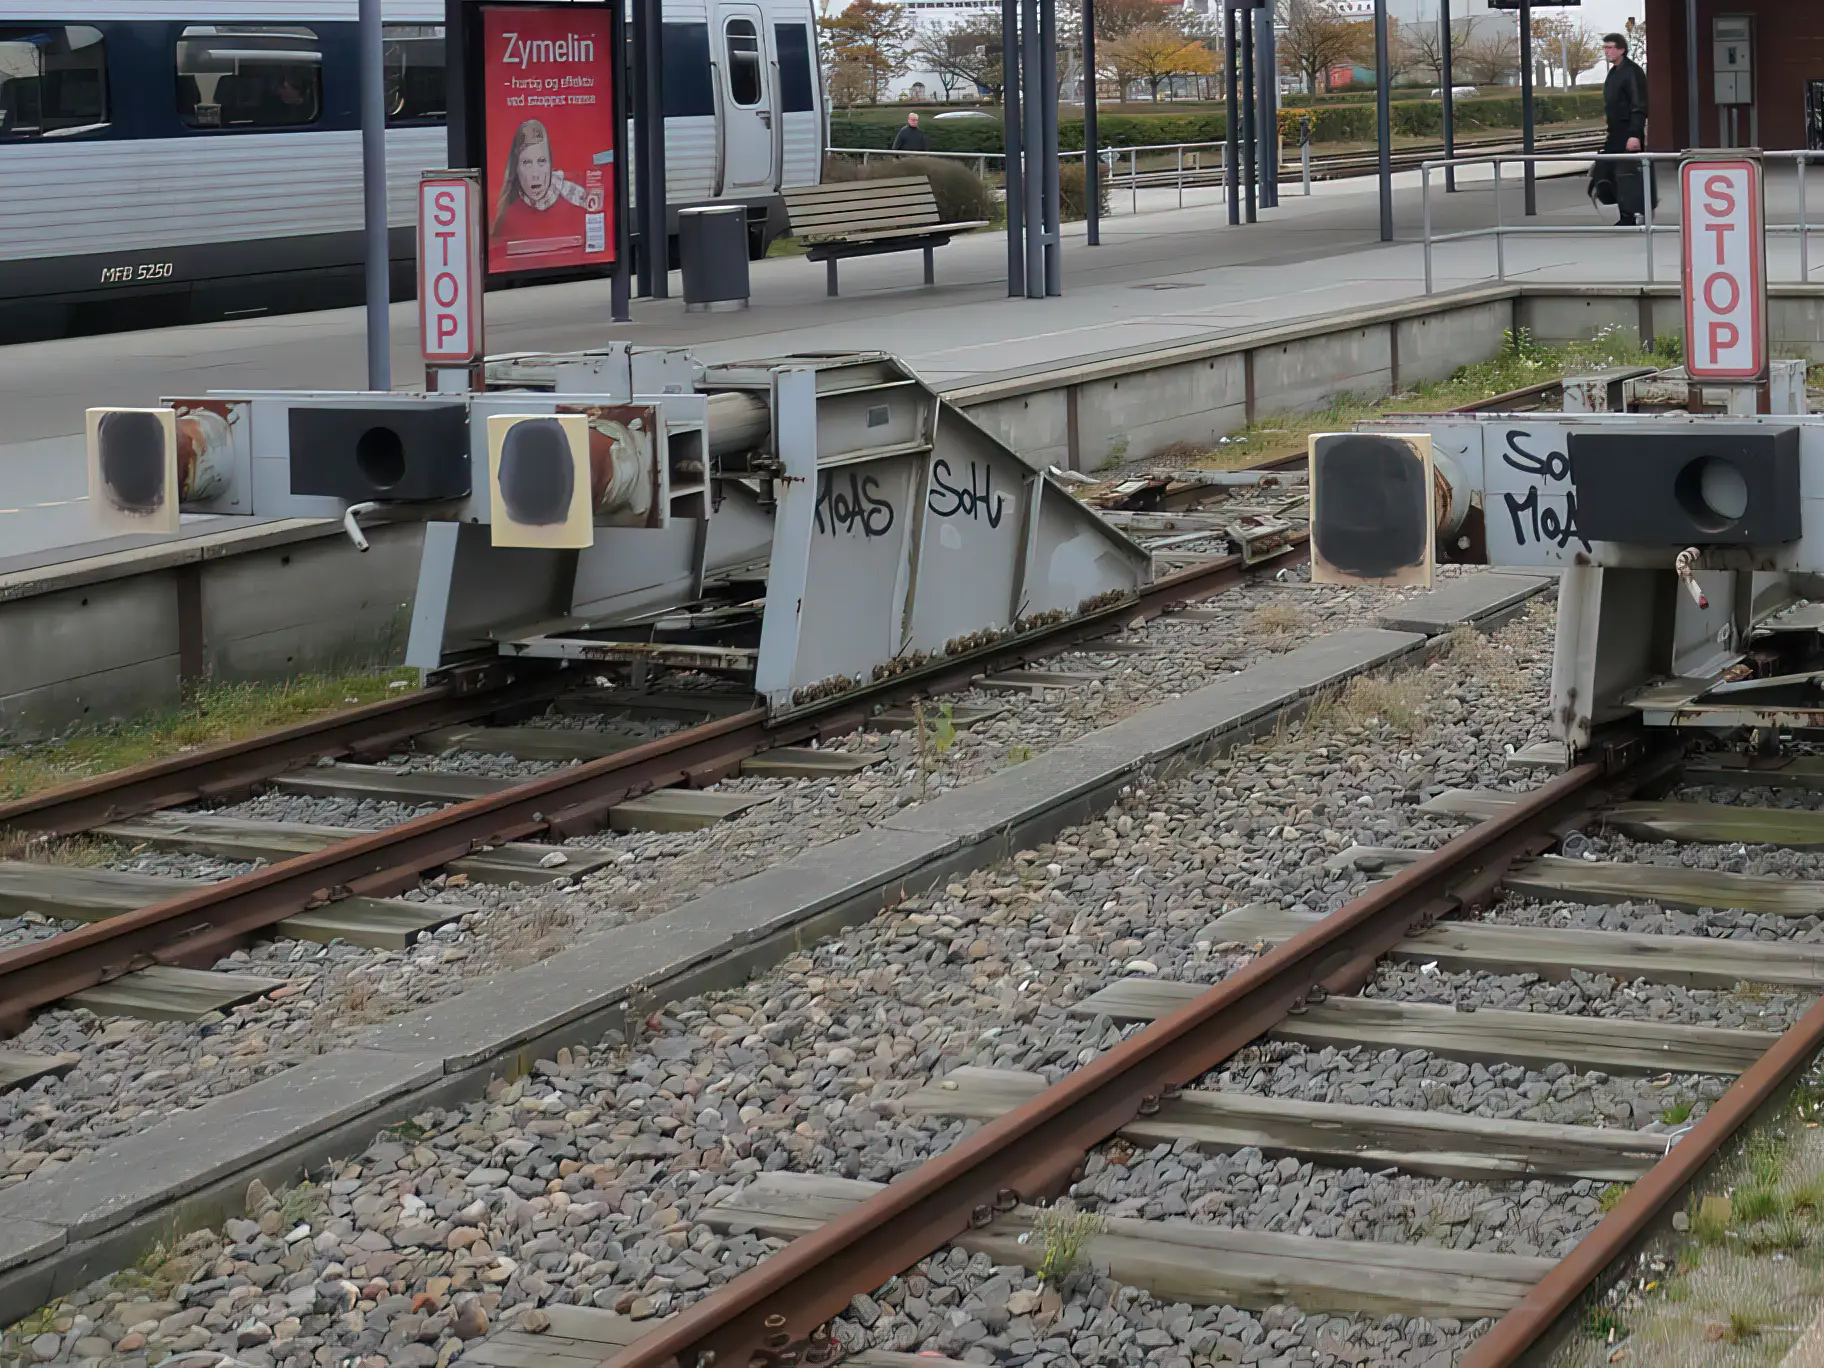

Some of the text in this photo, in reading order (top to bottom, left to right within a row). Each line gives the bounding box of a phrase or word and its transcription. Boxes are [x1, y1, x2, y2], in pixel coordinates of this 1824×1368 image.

[502, 33, 594, 69] Zymelin
[545, 78, 559, 91] og
[101, 263, 173, 283] MFB 5250
[433, 191, 459, 349] STOP
[1703, 175, 1740, 365] STOP
